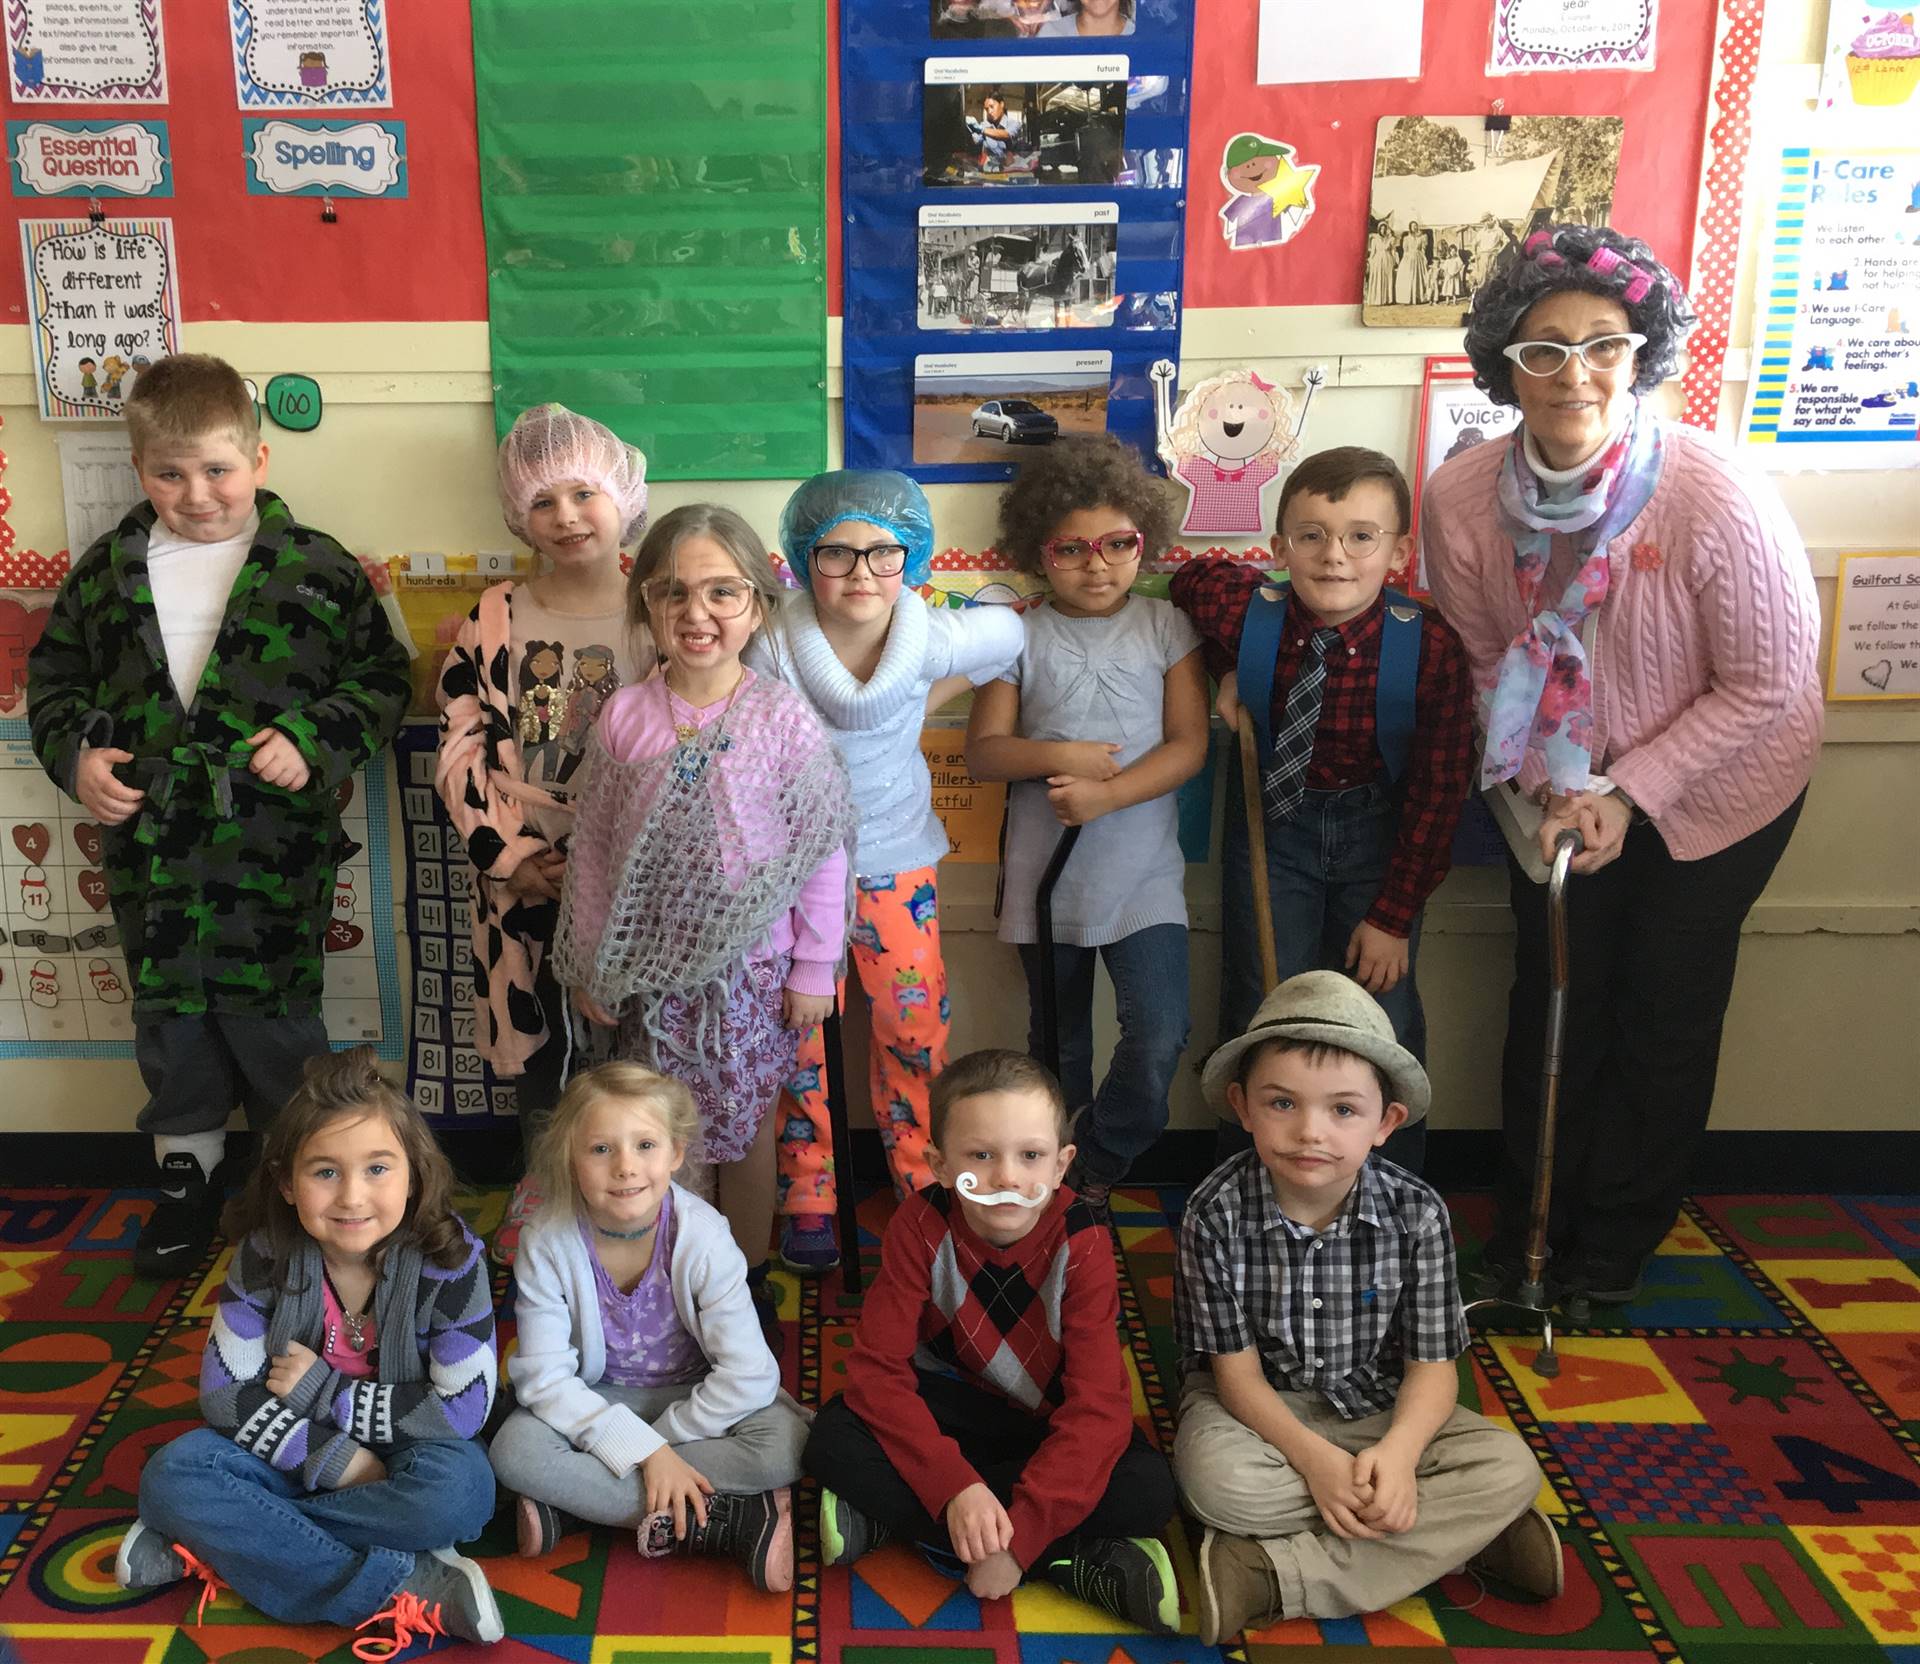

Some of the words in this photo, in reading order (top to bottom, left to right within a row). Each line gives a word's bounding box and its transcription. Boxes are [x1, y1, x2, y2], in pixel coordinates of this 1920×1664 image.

[265, 7, 312, 15] understand
[314, 6, 333, 14] what
[336, 7, 350, 15] you
[264, 19, 284, 27] read
[286, 18, 313, 26] better
[316, 18, 330, 26] and
[331, 18, 353, 26] helps
[105, 30, 135, 38] stories
[260, 33, 275, 41] you
[277, 31, 319, 39] remember
[79, 44, 96, 53] give
[1096, 64, 1120, 73] future
[40, 136, 138, 156] Essential
[274, 140, 375, 171] Spelling
[43, 157, 139, 177] Question
[1813, 159, 1895, 180] I-Care
[1811, 183, 1878, 204] Rles
[1094, 209, 1110, 218] past
[1817, 225, 1832, 233] We
[1837, 224, 1865, 233] listen
[1829, 234, 1854, 244] each
[1857, 234, 1886, 244] other
[51, 241, 86, 260] How
[94, 241, 106, 260] is
[116, 239, 146, 260] life
[1864, 257, 1898, 267] Hands
[1864, 268, 1879, 278] for
[62, 271, 142, 290] different
[53, 300, 97, 319] than
[104, 300, 115, 319] it
[124, 303, 155, 319] was
[1812, 303, 1829, 313] We
[67, 331, 106, 357] long
[115, 329, 150, 356] ago?
[1847, 338, 1864, 347] We
[1894, 337, 1920, 347] abou
[1845, 349, 1870, 358] each
[1874, 348, 1909, 358] other's
[1075, 358, 1103, 368] present
[1844, 360, 1888, 372] feelings.
[1789, 384, 1799, 393] 5.
[1800, 384, 1817, 393] We
[1821, 385, 1838, 393] are
[276, 391, 311, 416] 100
[1798, 395, 1859, 406] responsible
[1450, 408, 1504, 425] Voice
[1795, 405, 1811, 415] for
[1814, 405, 1842, 415] what
[1793, 417, 1811, 427] say
[1815, 415, 1836, 425] and
[1839, 415, 1856, 425] do.
[489, 557, 499, 569] 0
[405, 573, 456, 585] hundreds
[1852, 574, 1902, 586] Guilford
[1886, 601, 1899, 611] At
[1849, 623, 1863, 631] we
[1866, 620, 1898, 631] follow
[1901, 619, 1918, 630] the
[1854, 641, 1871, 650] We
[1874, 640, 1906, 650] follow
[1900, 659, 1918, 669] We
[410, 794, 426, 815] 11
[25, 838, 37, 849] 4
[87, 839, 99, 852] 5
[418, 832, 436, 853] 21
[421, 869, 439, 889] 31
[87, 882, 105, 895] 12
[28, 893, 43, 906] 11
[334, 895, 350, 908] 16
[421, 905, 441, 926] 41
[29, 933, 46, 946] 18
[89, 930, 107, 944] 19
[331, 925, 352, 942] 23
[425, 942, 442, 963] 51
[35, 981, 55, 995] 25
[98, 978, 118, 992] 26
[422, 978, 438, 997] 61
[420, 1013, 435, 1033] 71
[423, 1050, 440, 1069] 81
[455, 1053, 481, 1073] 82
[420, 1087, 439, 1106] 91
[456, 1089, 484, 1108] 92
